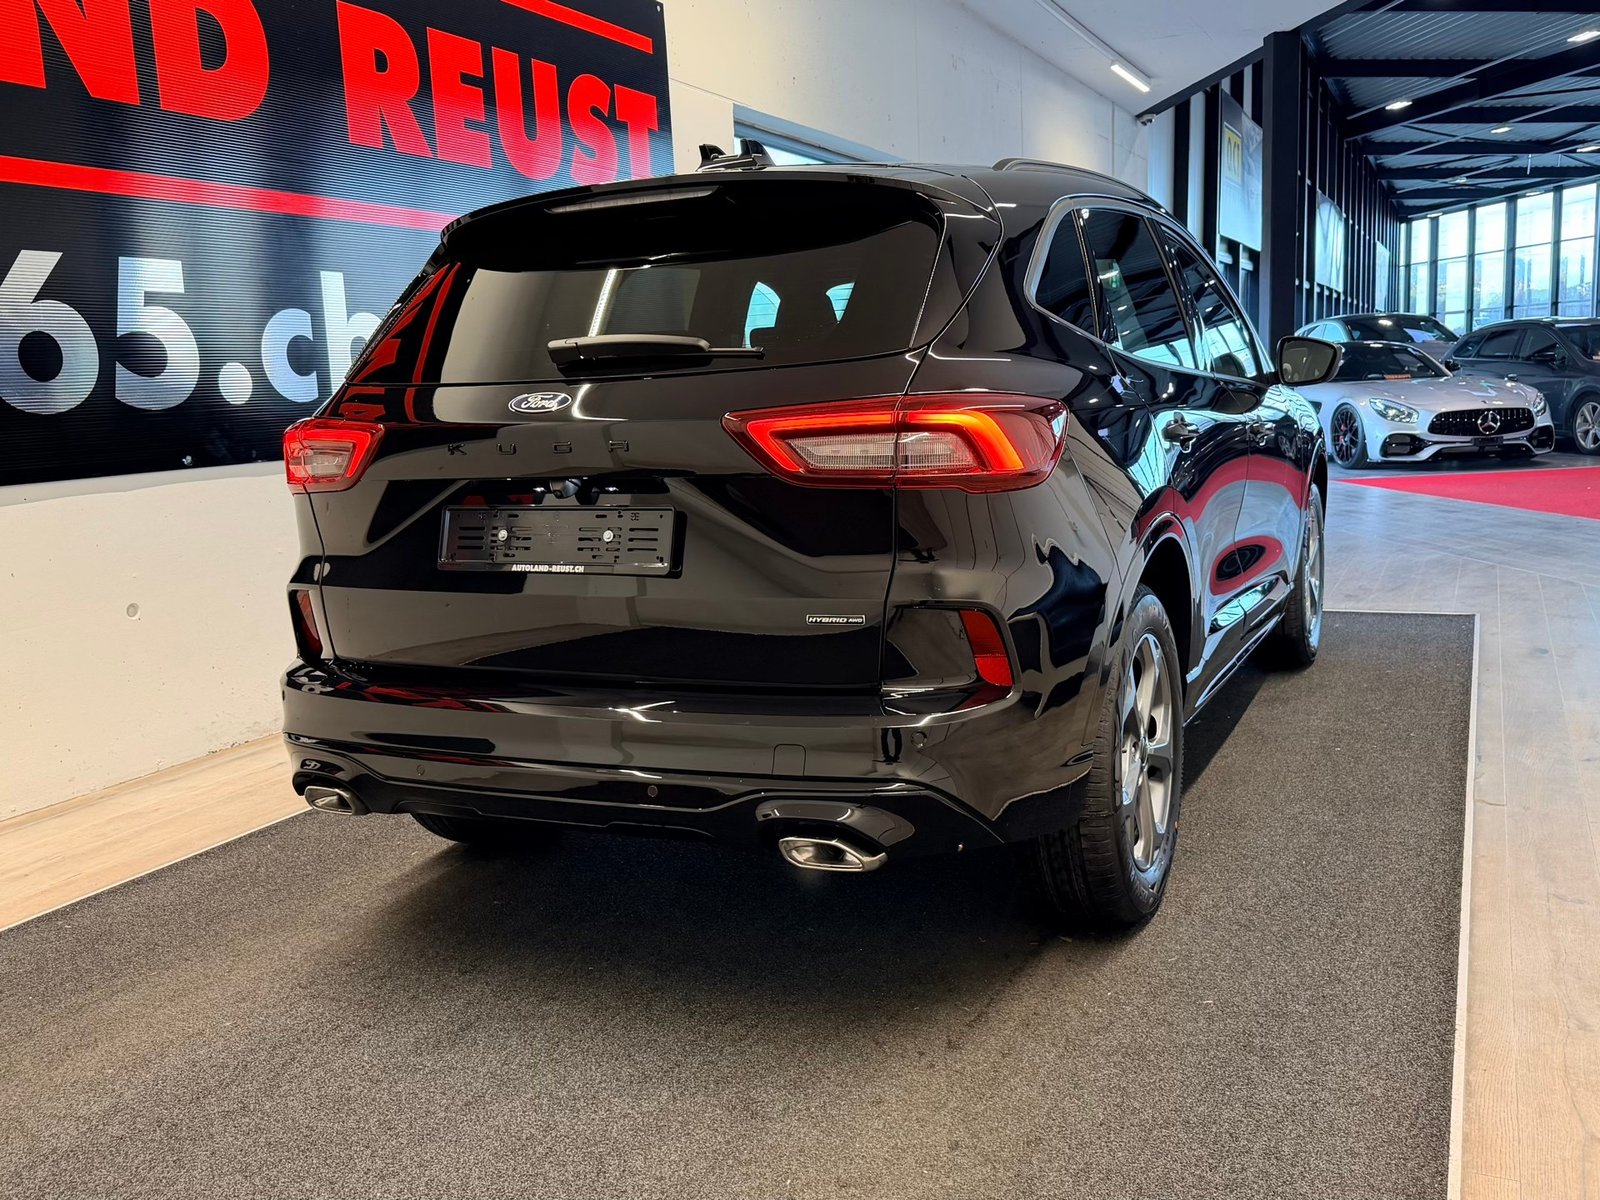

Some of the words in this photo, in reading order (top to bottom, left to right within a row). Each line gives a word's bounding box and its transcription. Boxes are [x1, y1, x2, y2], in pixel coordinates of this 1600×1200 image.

[0, 0, 269, 122] ND
[336, 0, 658, 184] REUST
[0, 249, 383, 415] 65.ch
[519, 392, 566, 411] Ford
[447, 440, 630, 456] KUGA
[511, 564, 584, 573] AUTOLAND-REUST.CH
